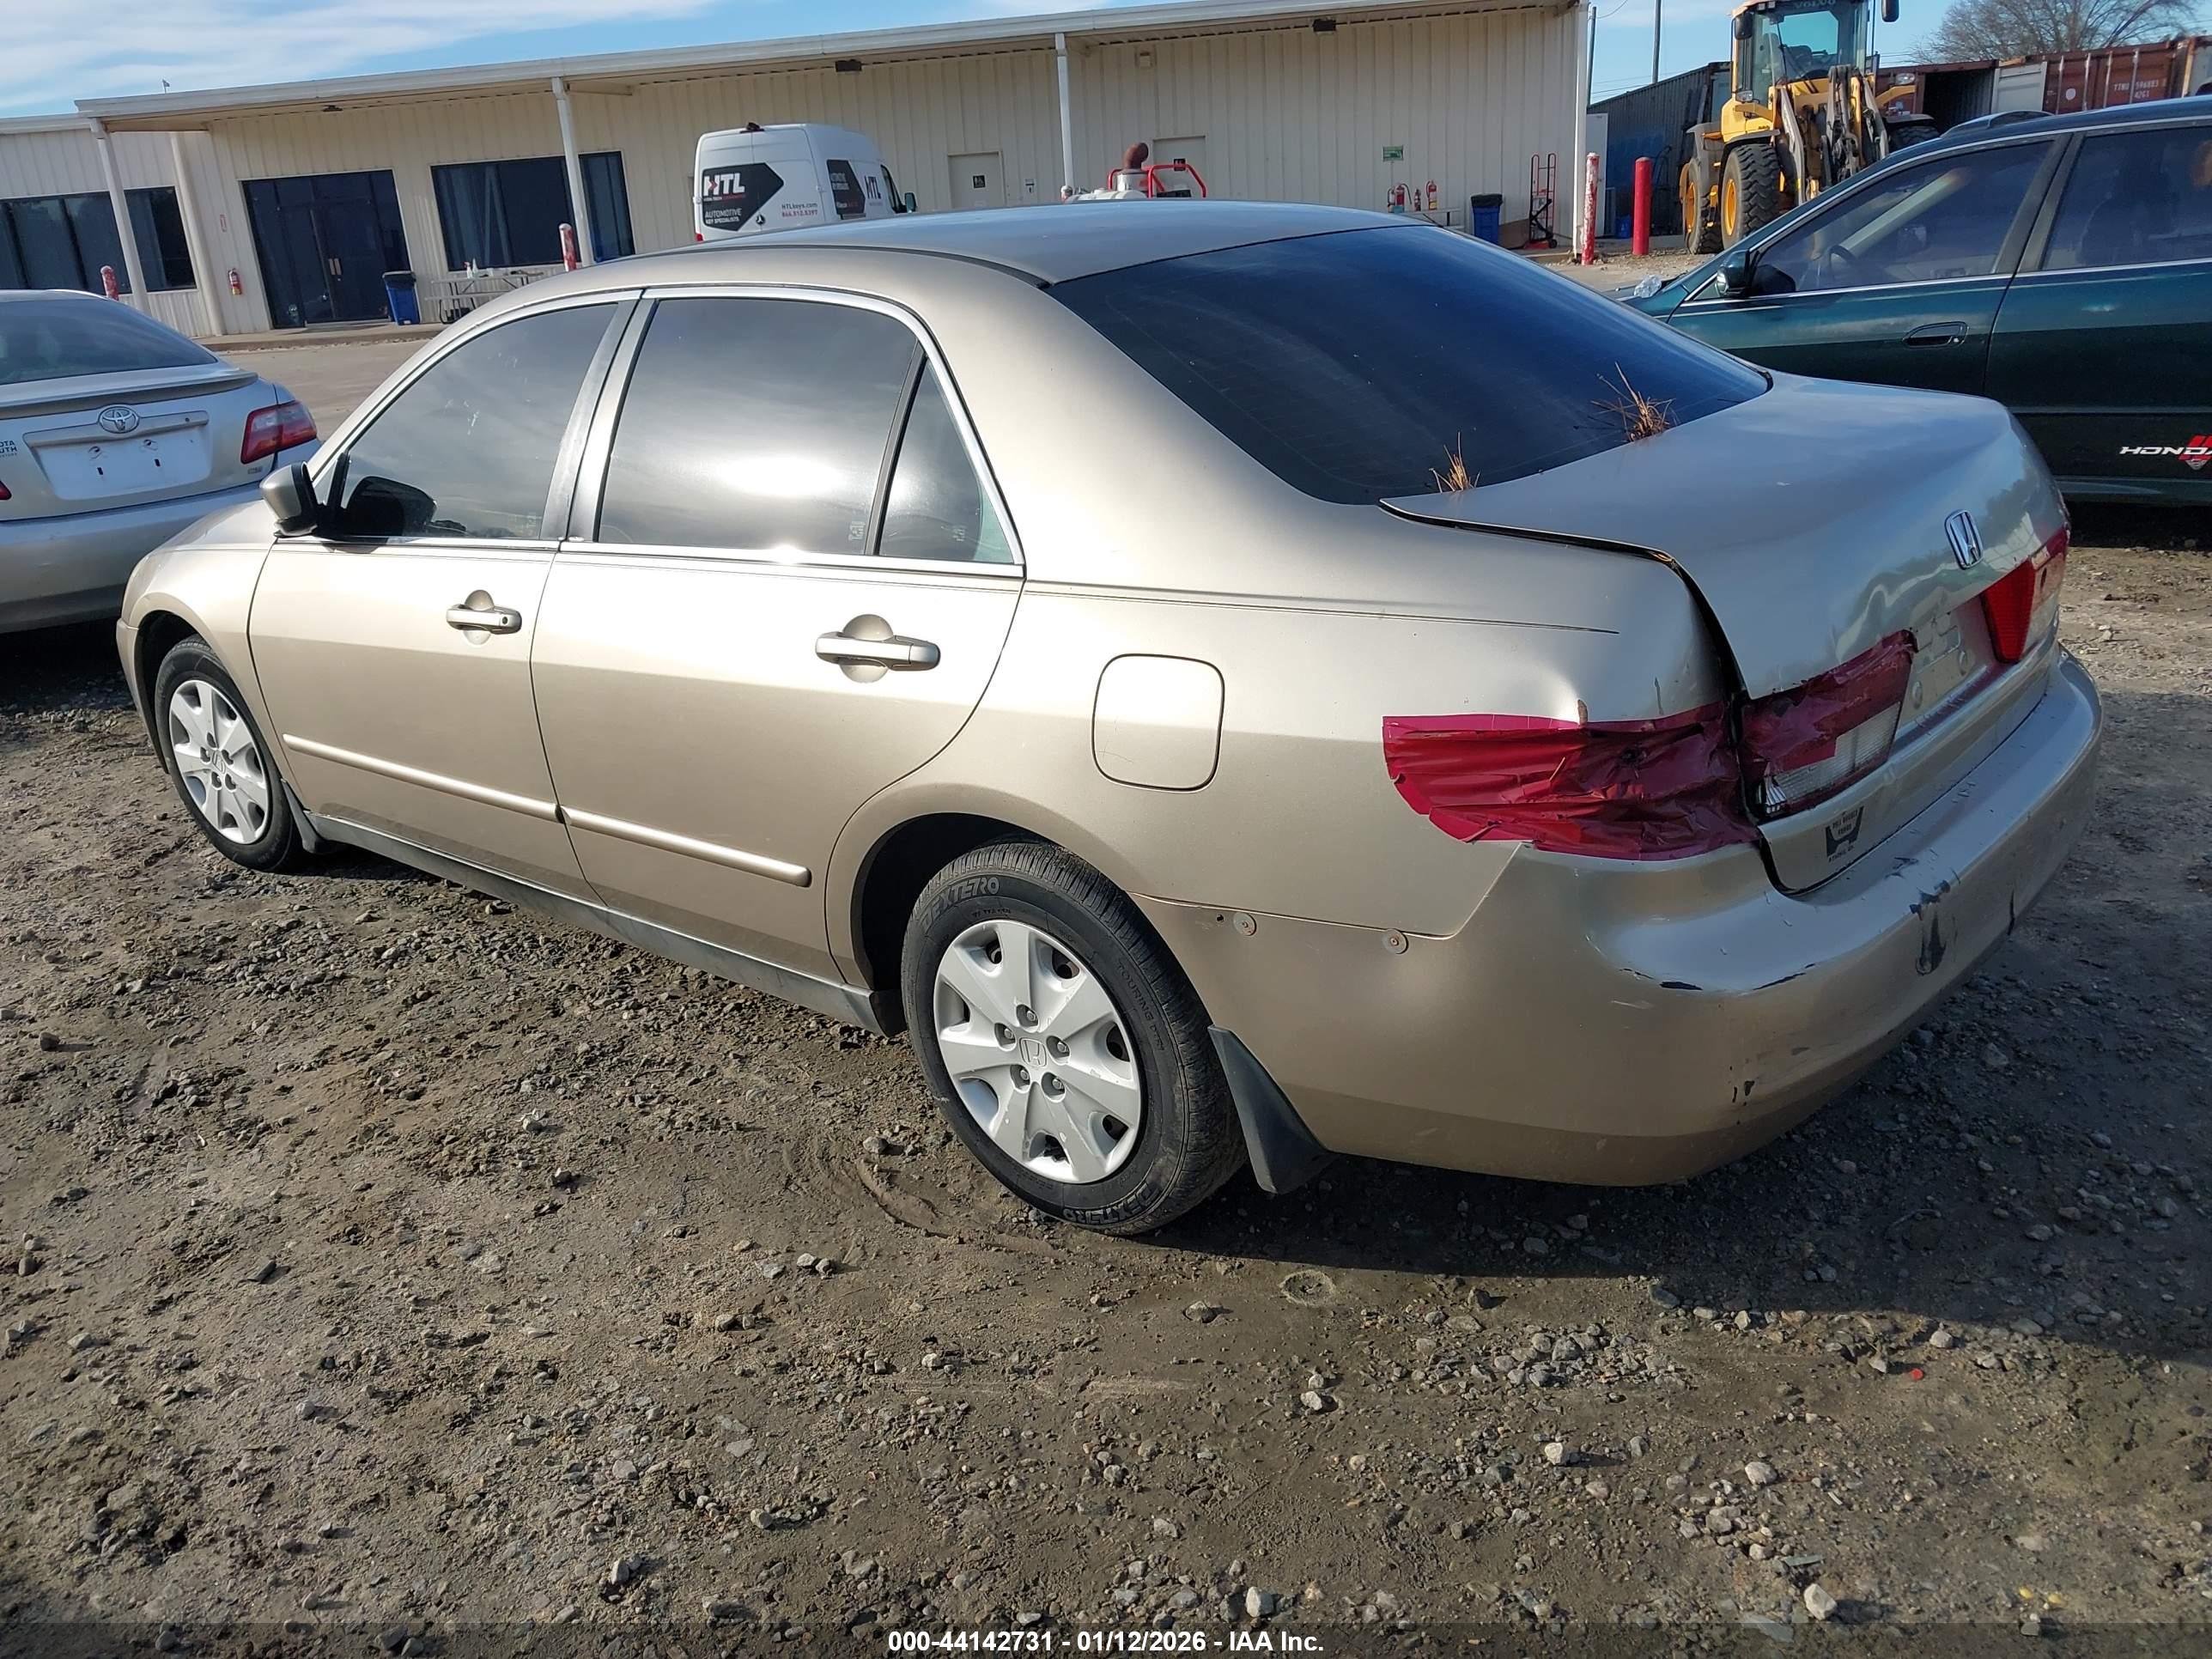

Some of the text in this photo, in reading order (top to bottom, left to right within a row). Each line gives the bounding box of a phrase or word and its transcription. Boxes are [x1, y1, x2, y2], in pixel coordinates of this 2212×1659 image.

[702, 173, 745, 197] HTL
[864, 175, 882, 199] HTL
[704, 208, 743, 219] AUTOMOTIVE
[921, 877, 1000, 930] DEXTERO
[1116, 961, 1155, 1022] TOURING
[1063, 1182, 1160, 1224] DEXTERO
